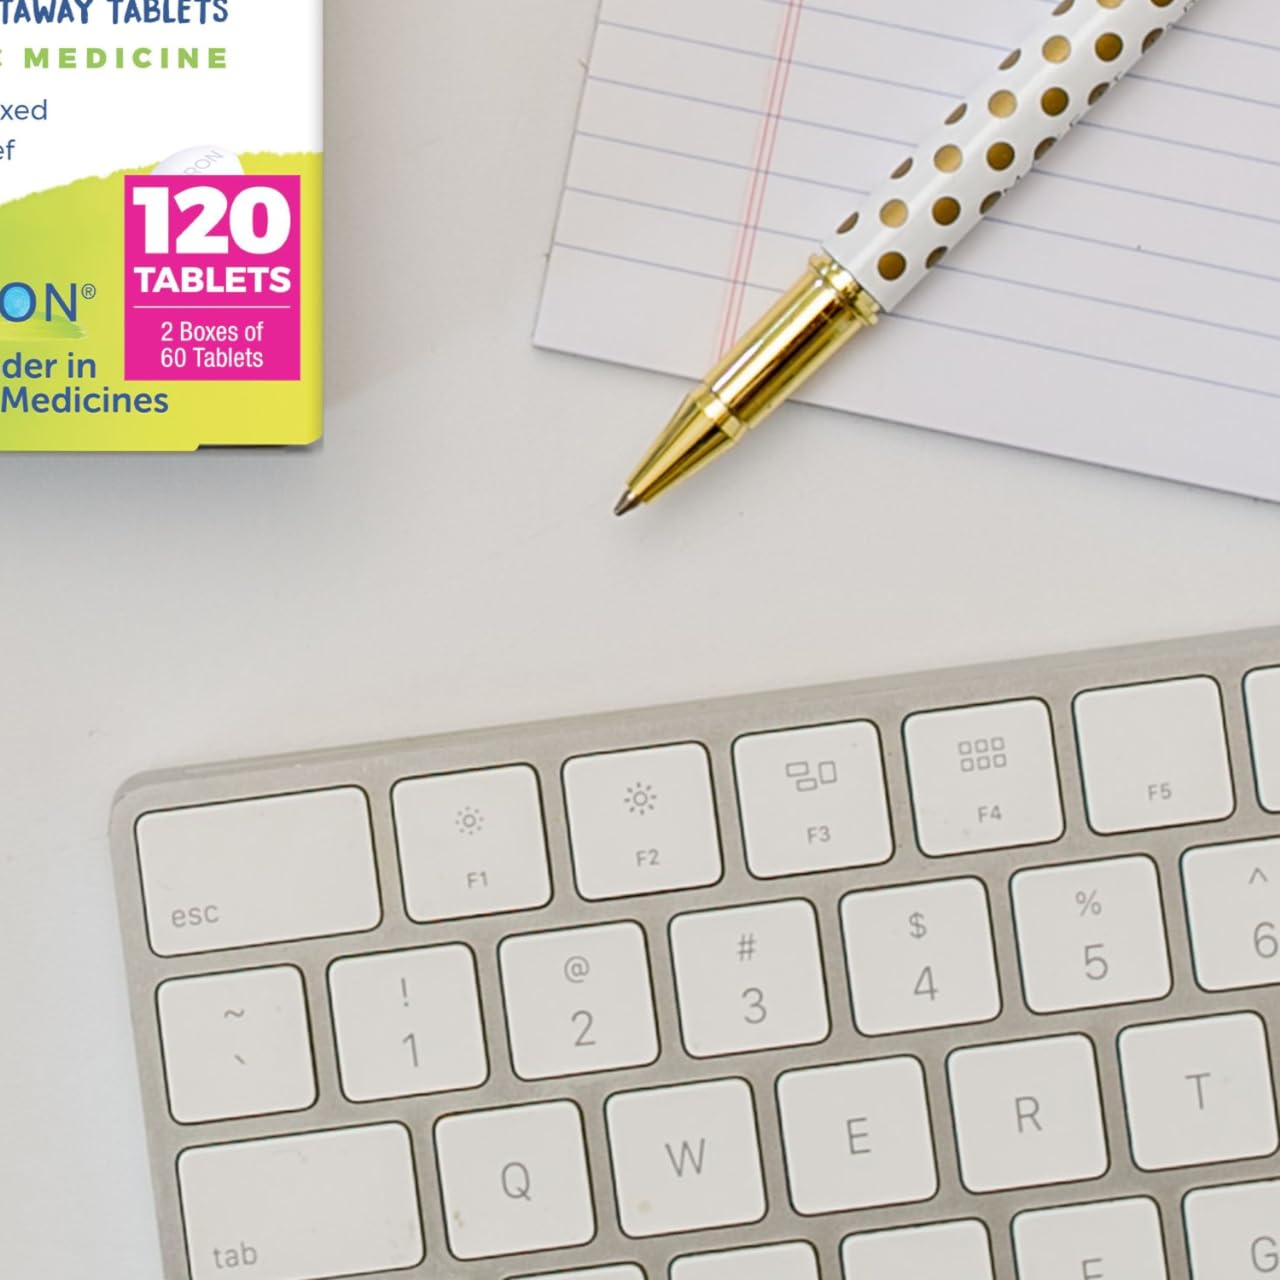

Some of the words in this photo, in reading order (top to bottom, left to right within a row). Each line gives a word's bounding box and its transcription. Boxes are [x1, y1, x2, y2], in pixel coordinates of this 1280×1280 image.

[24, 47, 226, 69] MEDICINE
[133, 186, 291, 254] 120
[134, 266, 291, 293] TABLETS
[161, 321, 173, 341] 2
[180, 321, 238, 342] Boxes
[245, 321, 264, 341] of
[68, 352, 95, 378] in
[161, 347, 186, 367] 60
[193, 347, 263, 367] Tablets
[1, 386, 168, 413] Medicines
[1148, 782, 1172, 800] F5
[978, 805, 1002, 822] F4
[807, 825, 831, 844] F3
[636, 848, 659, 867] F2
[467, 872, 488, 888] F1
[172, 905, 219, 928] esc
[1075, 890, 1102, 916] %
[909, 912, 927, 939] $
[738, 933, 755, 961] #
[1254, 921, 1278, 959] 6
[564, 956, 590, 983] @
[1085, 944, 1108, 980] 5
[401, 978, 409, 1007] !
[914, 966, 938, 1000] 4
[742, 987, 767, 1024] 3
[571, 1010, 596, 1047] 2
[403, 1033, 418, 1067] 1
[1185, 1072, 1211, 1110] T
[1015, 1096, 1042, 1133] R
[847, 1117, 871, 1155] E
[665, 1138, 705, 1177] W
[501, 1162, 531, 1201] Q
[213, 1242, 257, 1269] tab
[1251, 1236, 1279, 1273] G
